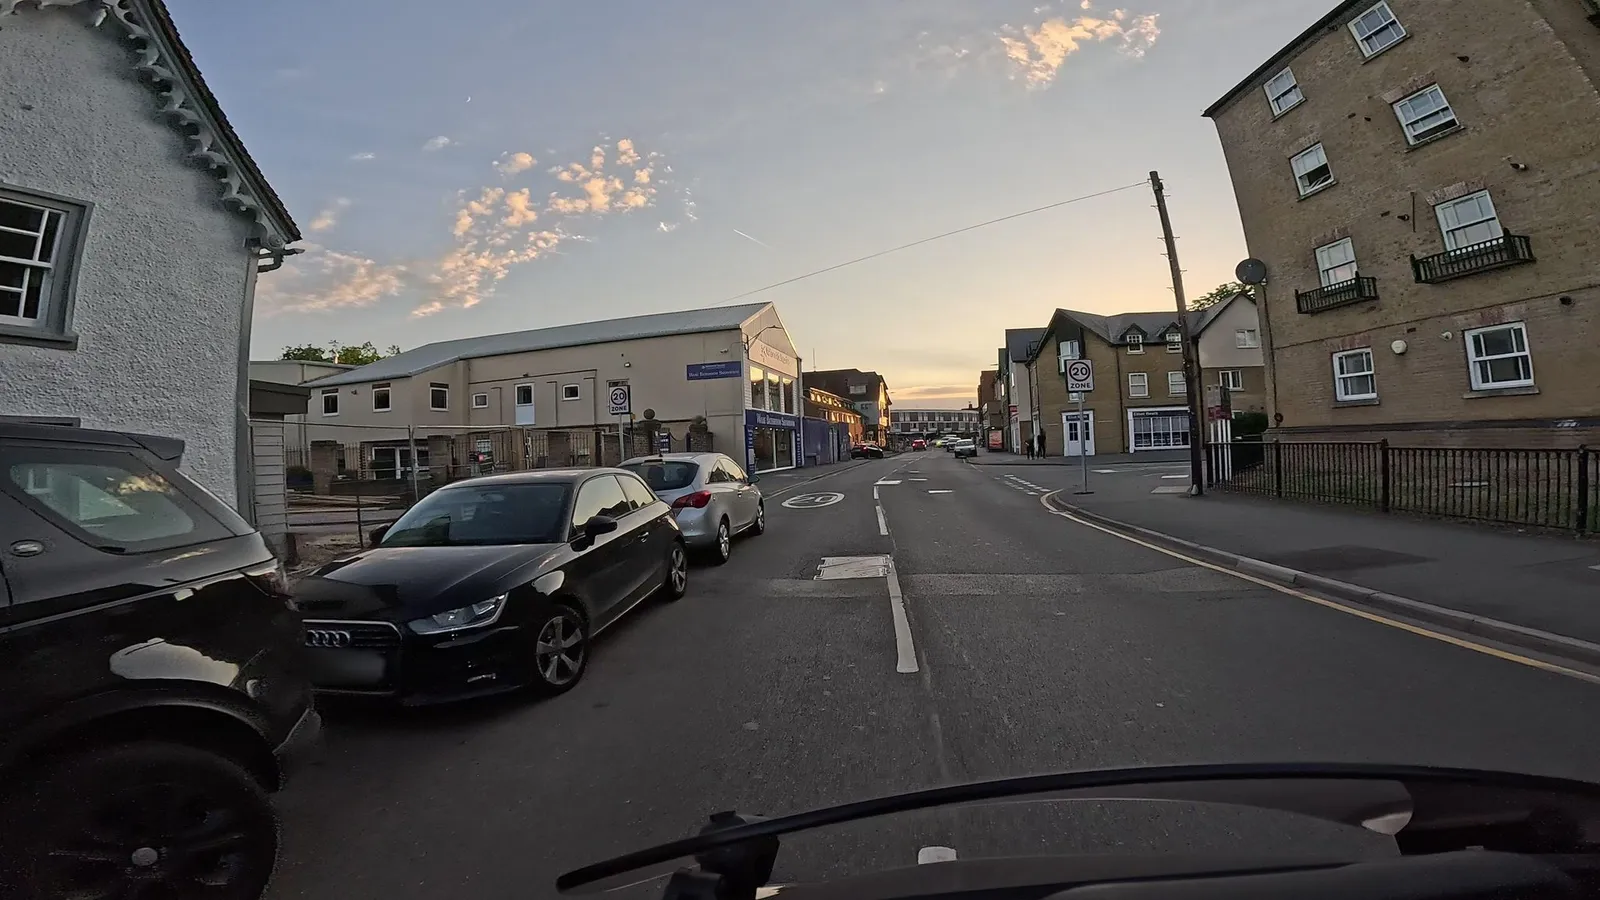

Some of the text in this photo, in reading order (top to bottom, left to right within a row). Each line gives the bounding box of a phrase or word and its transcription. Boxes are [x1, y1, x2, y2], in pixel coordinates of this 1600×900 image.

[1072, 367, 1088, 376] 20
[613, 392, 625, 401] 20
[789, 495, 838, 504] 20
